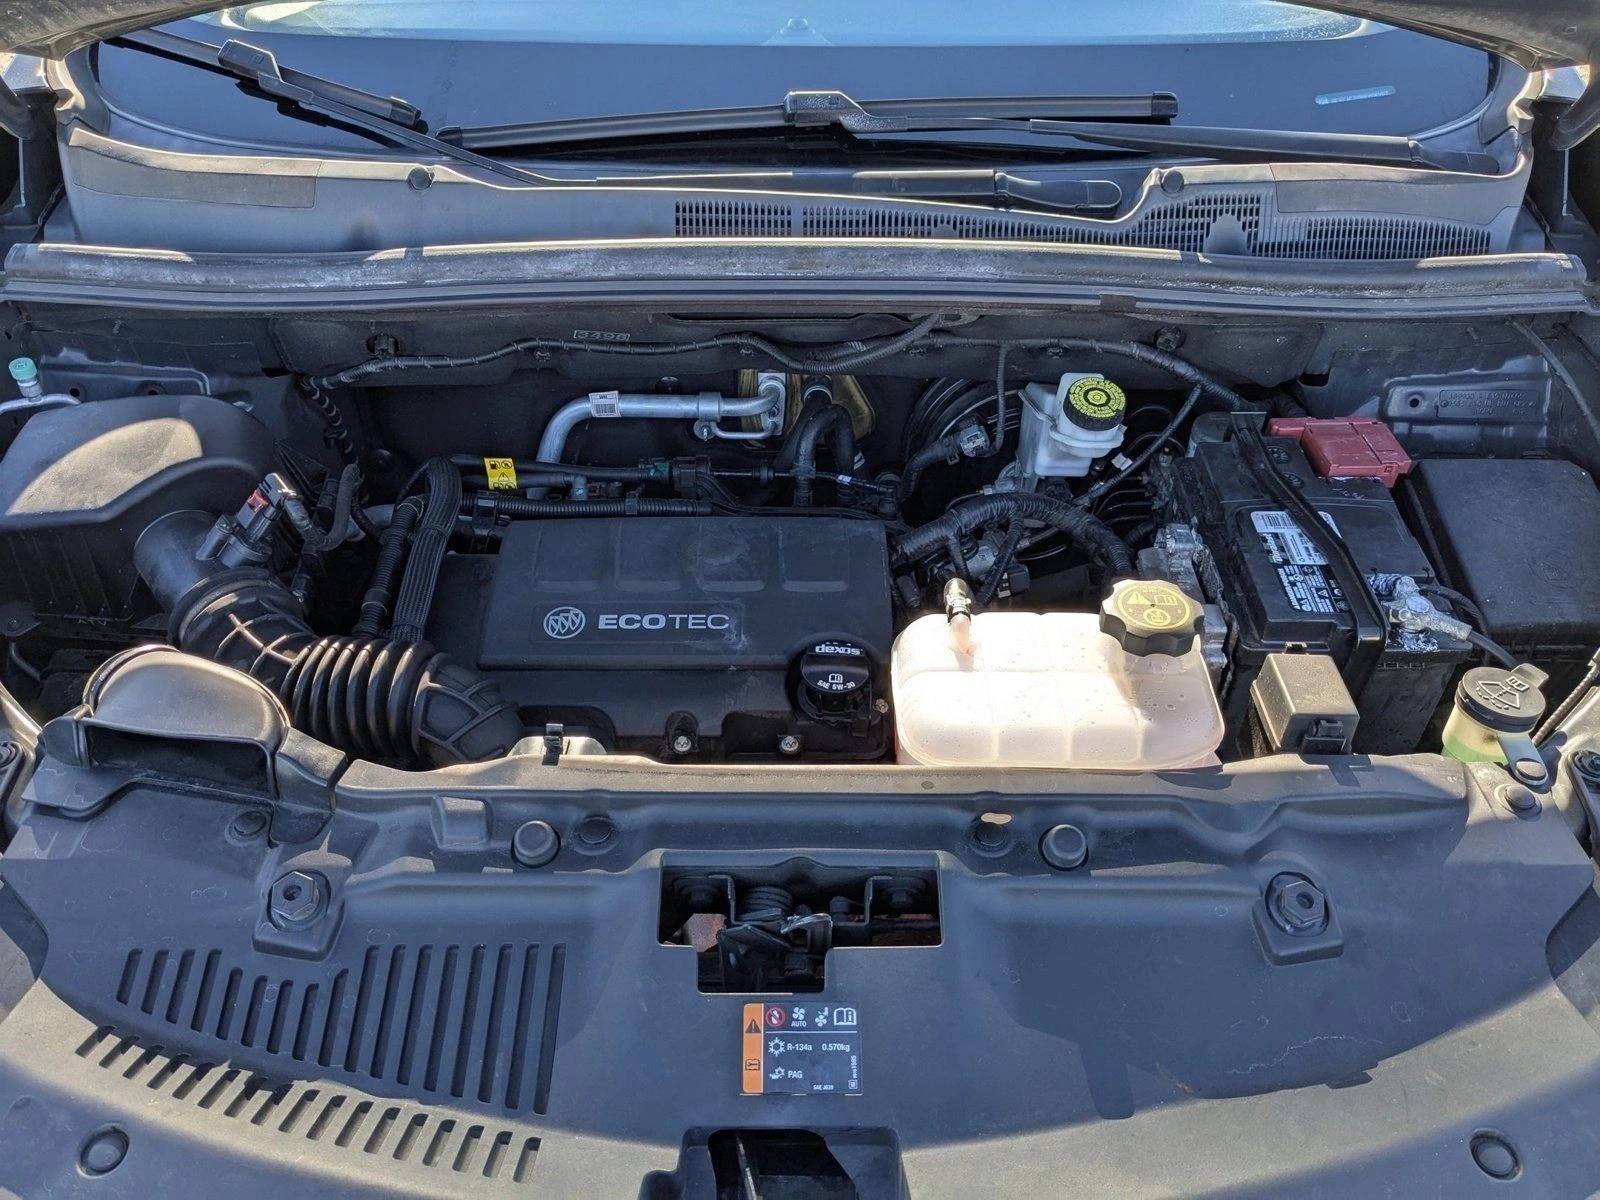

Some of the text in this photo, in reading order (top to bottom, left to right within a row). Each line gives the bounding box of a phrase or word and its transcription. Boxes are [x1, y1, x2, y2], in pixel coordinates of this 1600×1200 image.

[598, 614, 730, 629] ECOTEC
[815, 644, 860, 655] dexos
[817, 680, 830, 689] SAE
[787, 1043, 850, 1052] R-134a 0.570kg
[788, 1070, 803, 1079] PAG
